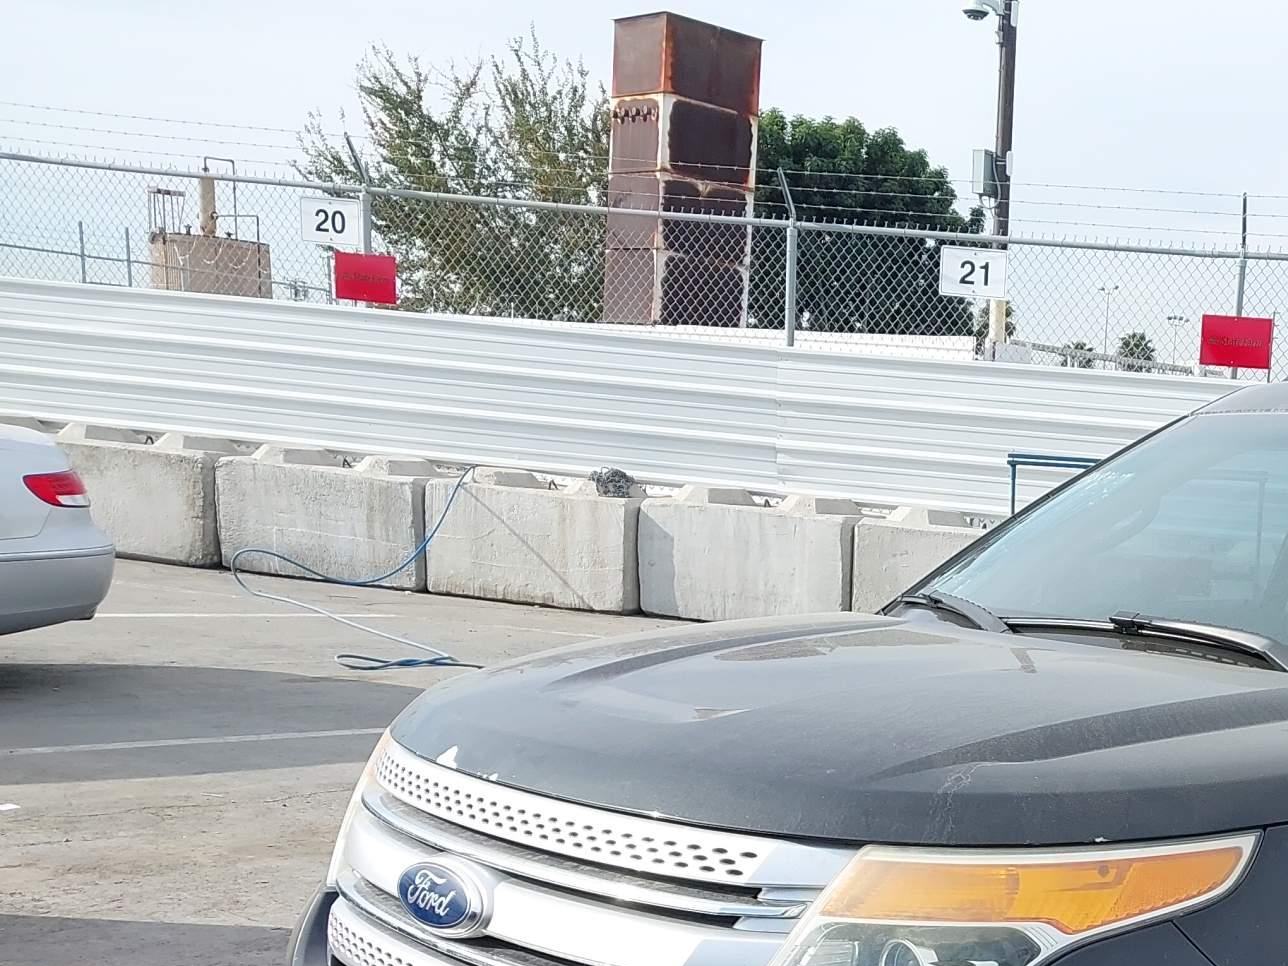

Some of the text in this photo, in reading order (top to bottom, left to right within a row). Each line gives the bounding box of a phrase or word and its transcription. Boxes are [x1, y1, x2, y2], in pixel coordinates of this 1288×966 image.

[315, 208, 346, 234] 20
[959, 260, 990, 286] 21
[407, 869, 456, 916] Ford
